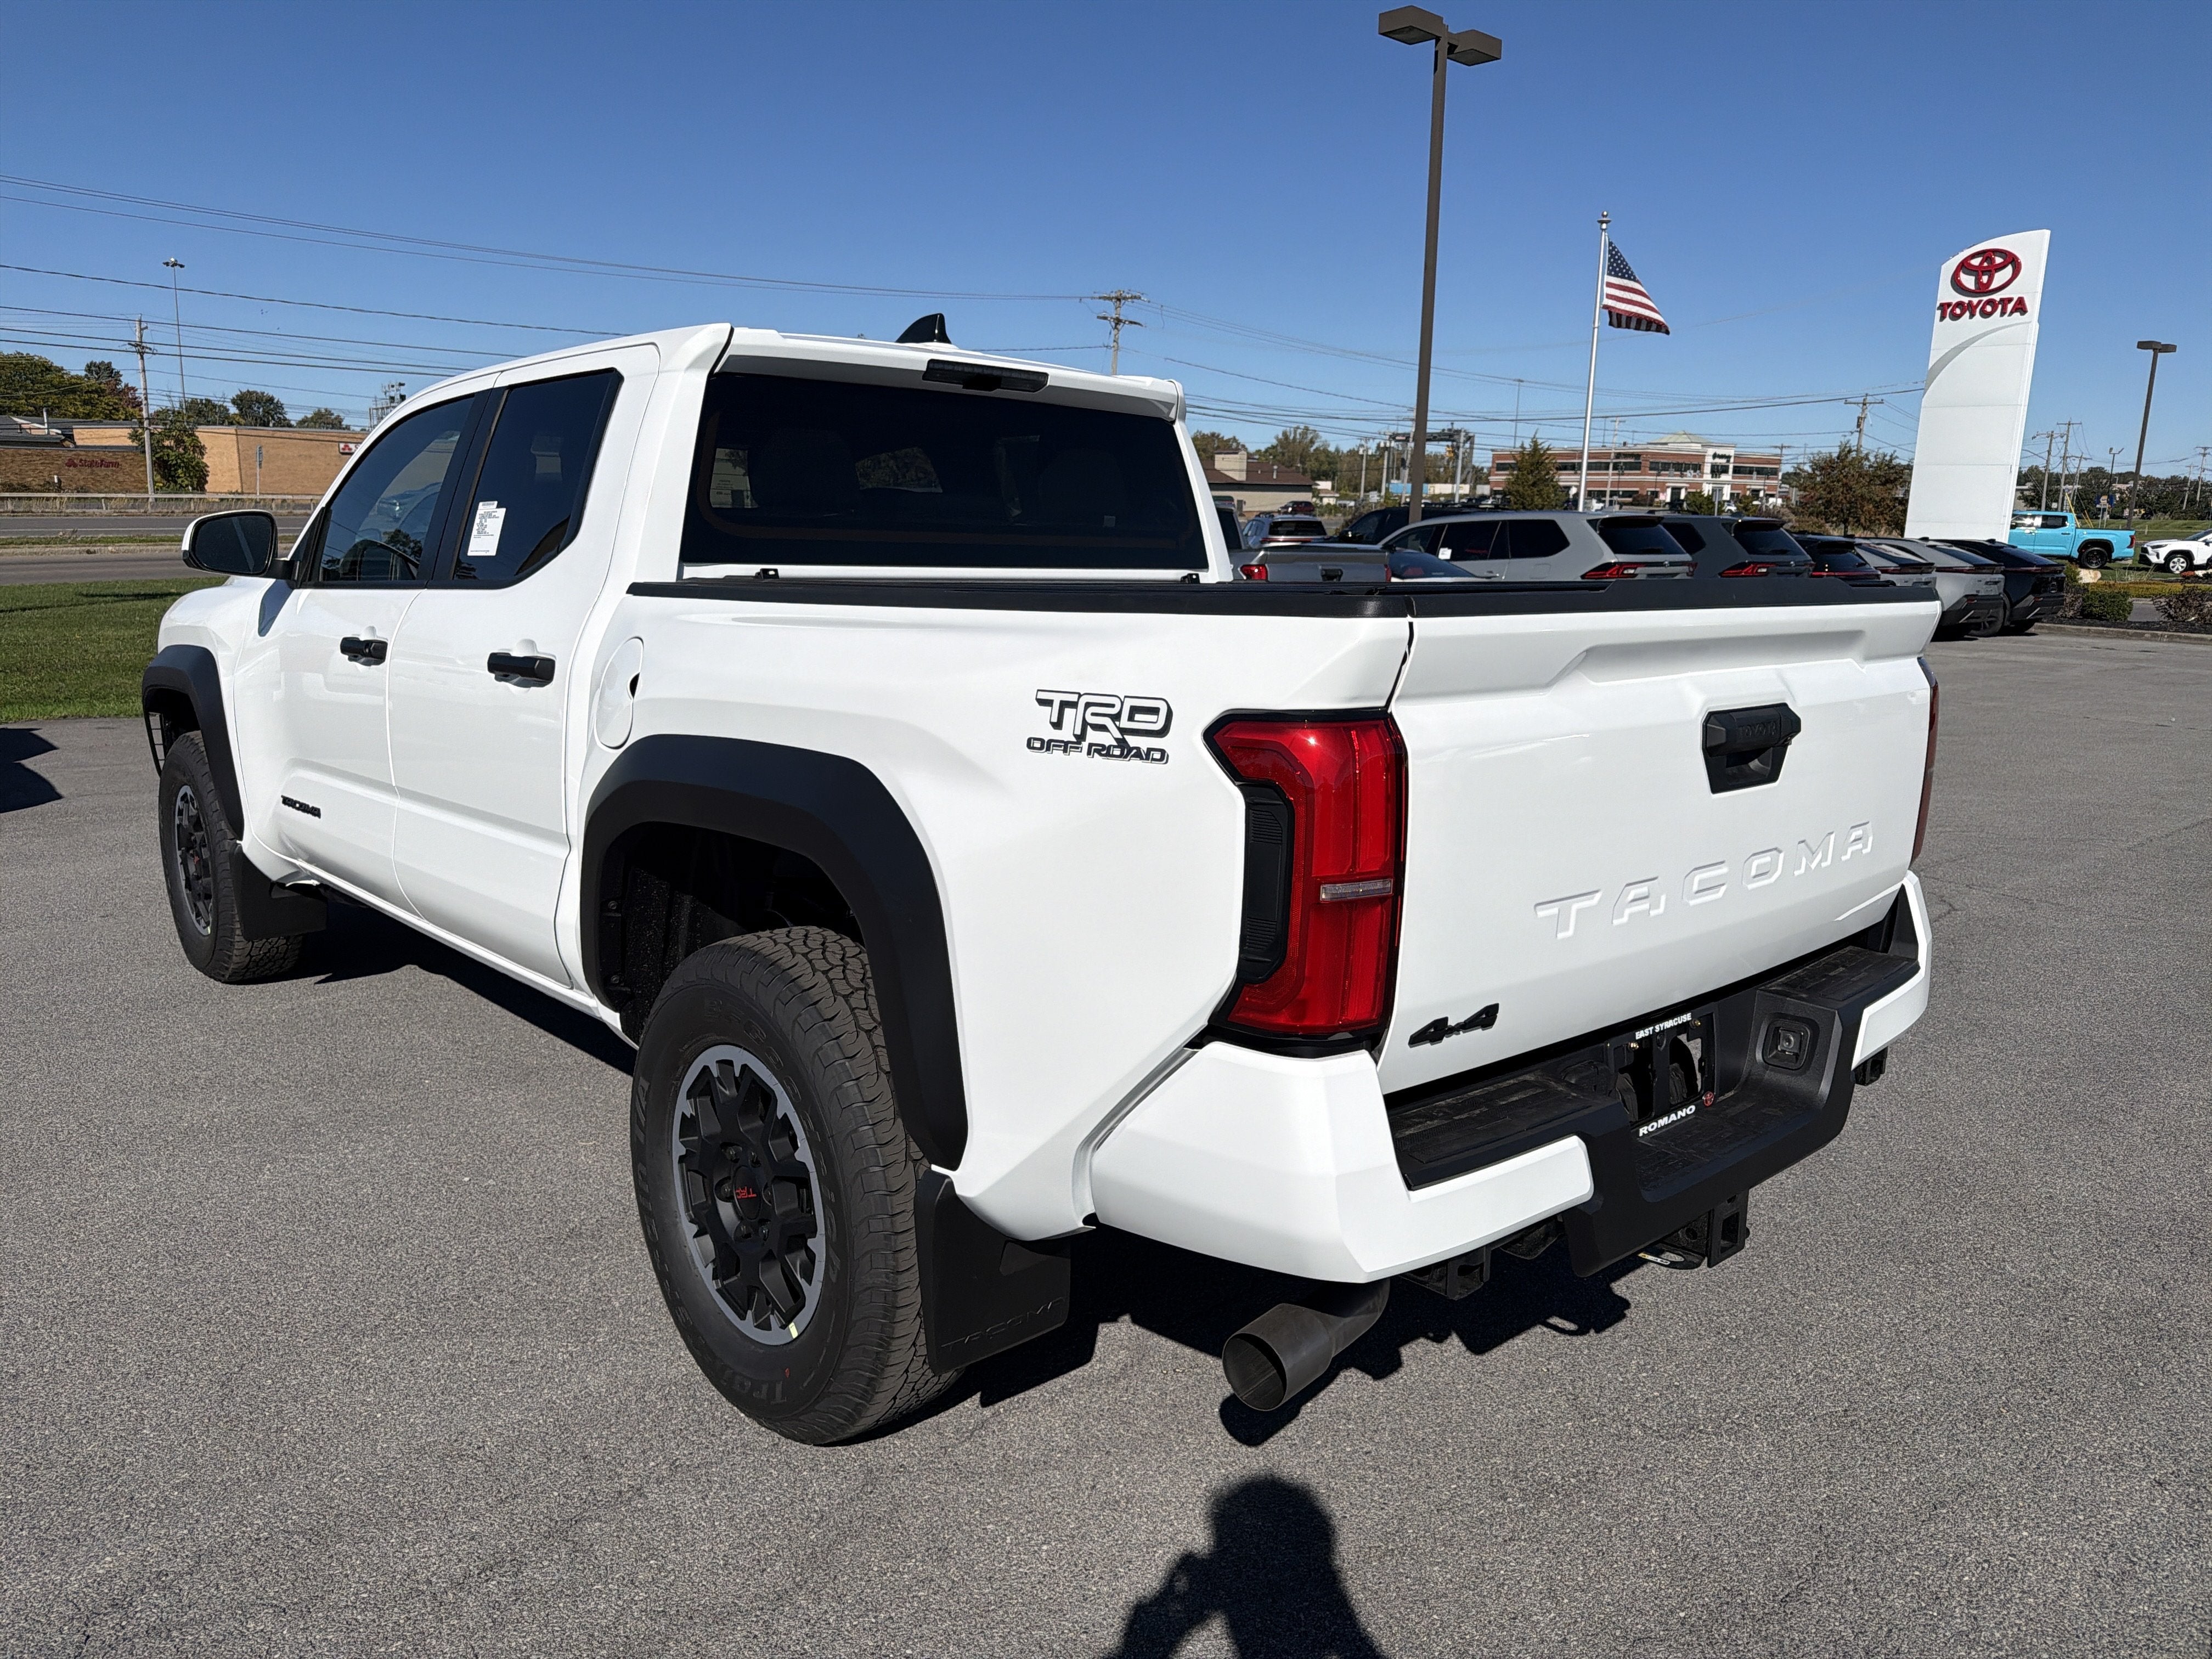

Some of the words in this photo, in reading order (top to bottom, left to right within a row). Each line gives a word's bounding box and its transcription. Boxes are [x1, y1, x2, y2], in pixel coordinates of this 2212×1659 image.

[1937, 296, 2028, 321] TOYOTA
[1035, 689, 1173, 743] TRD
[1737, 720, 1778, 740] TOYOTA
[1026, 737, 1084, 755] OFF
[1086, 742, 1170, 764] ROAD
[280, 794, 321, 819] TACOMA
[1534, 820, 1874, 940] TACOMA
[1635, 1026, 1654, 1040] EAST
[1655, 1012, 1692, 1033] SYRACUSE
[1639, 1104, 1696, 1137] ROMANO
